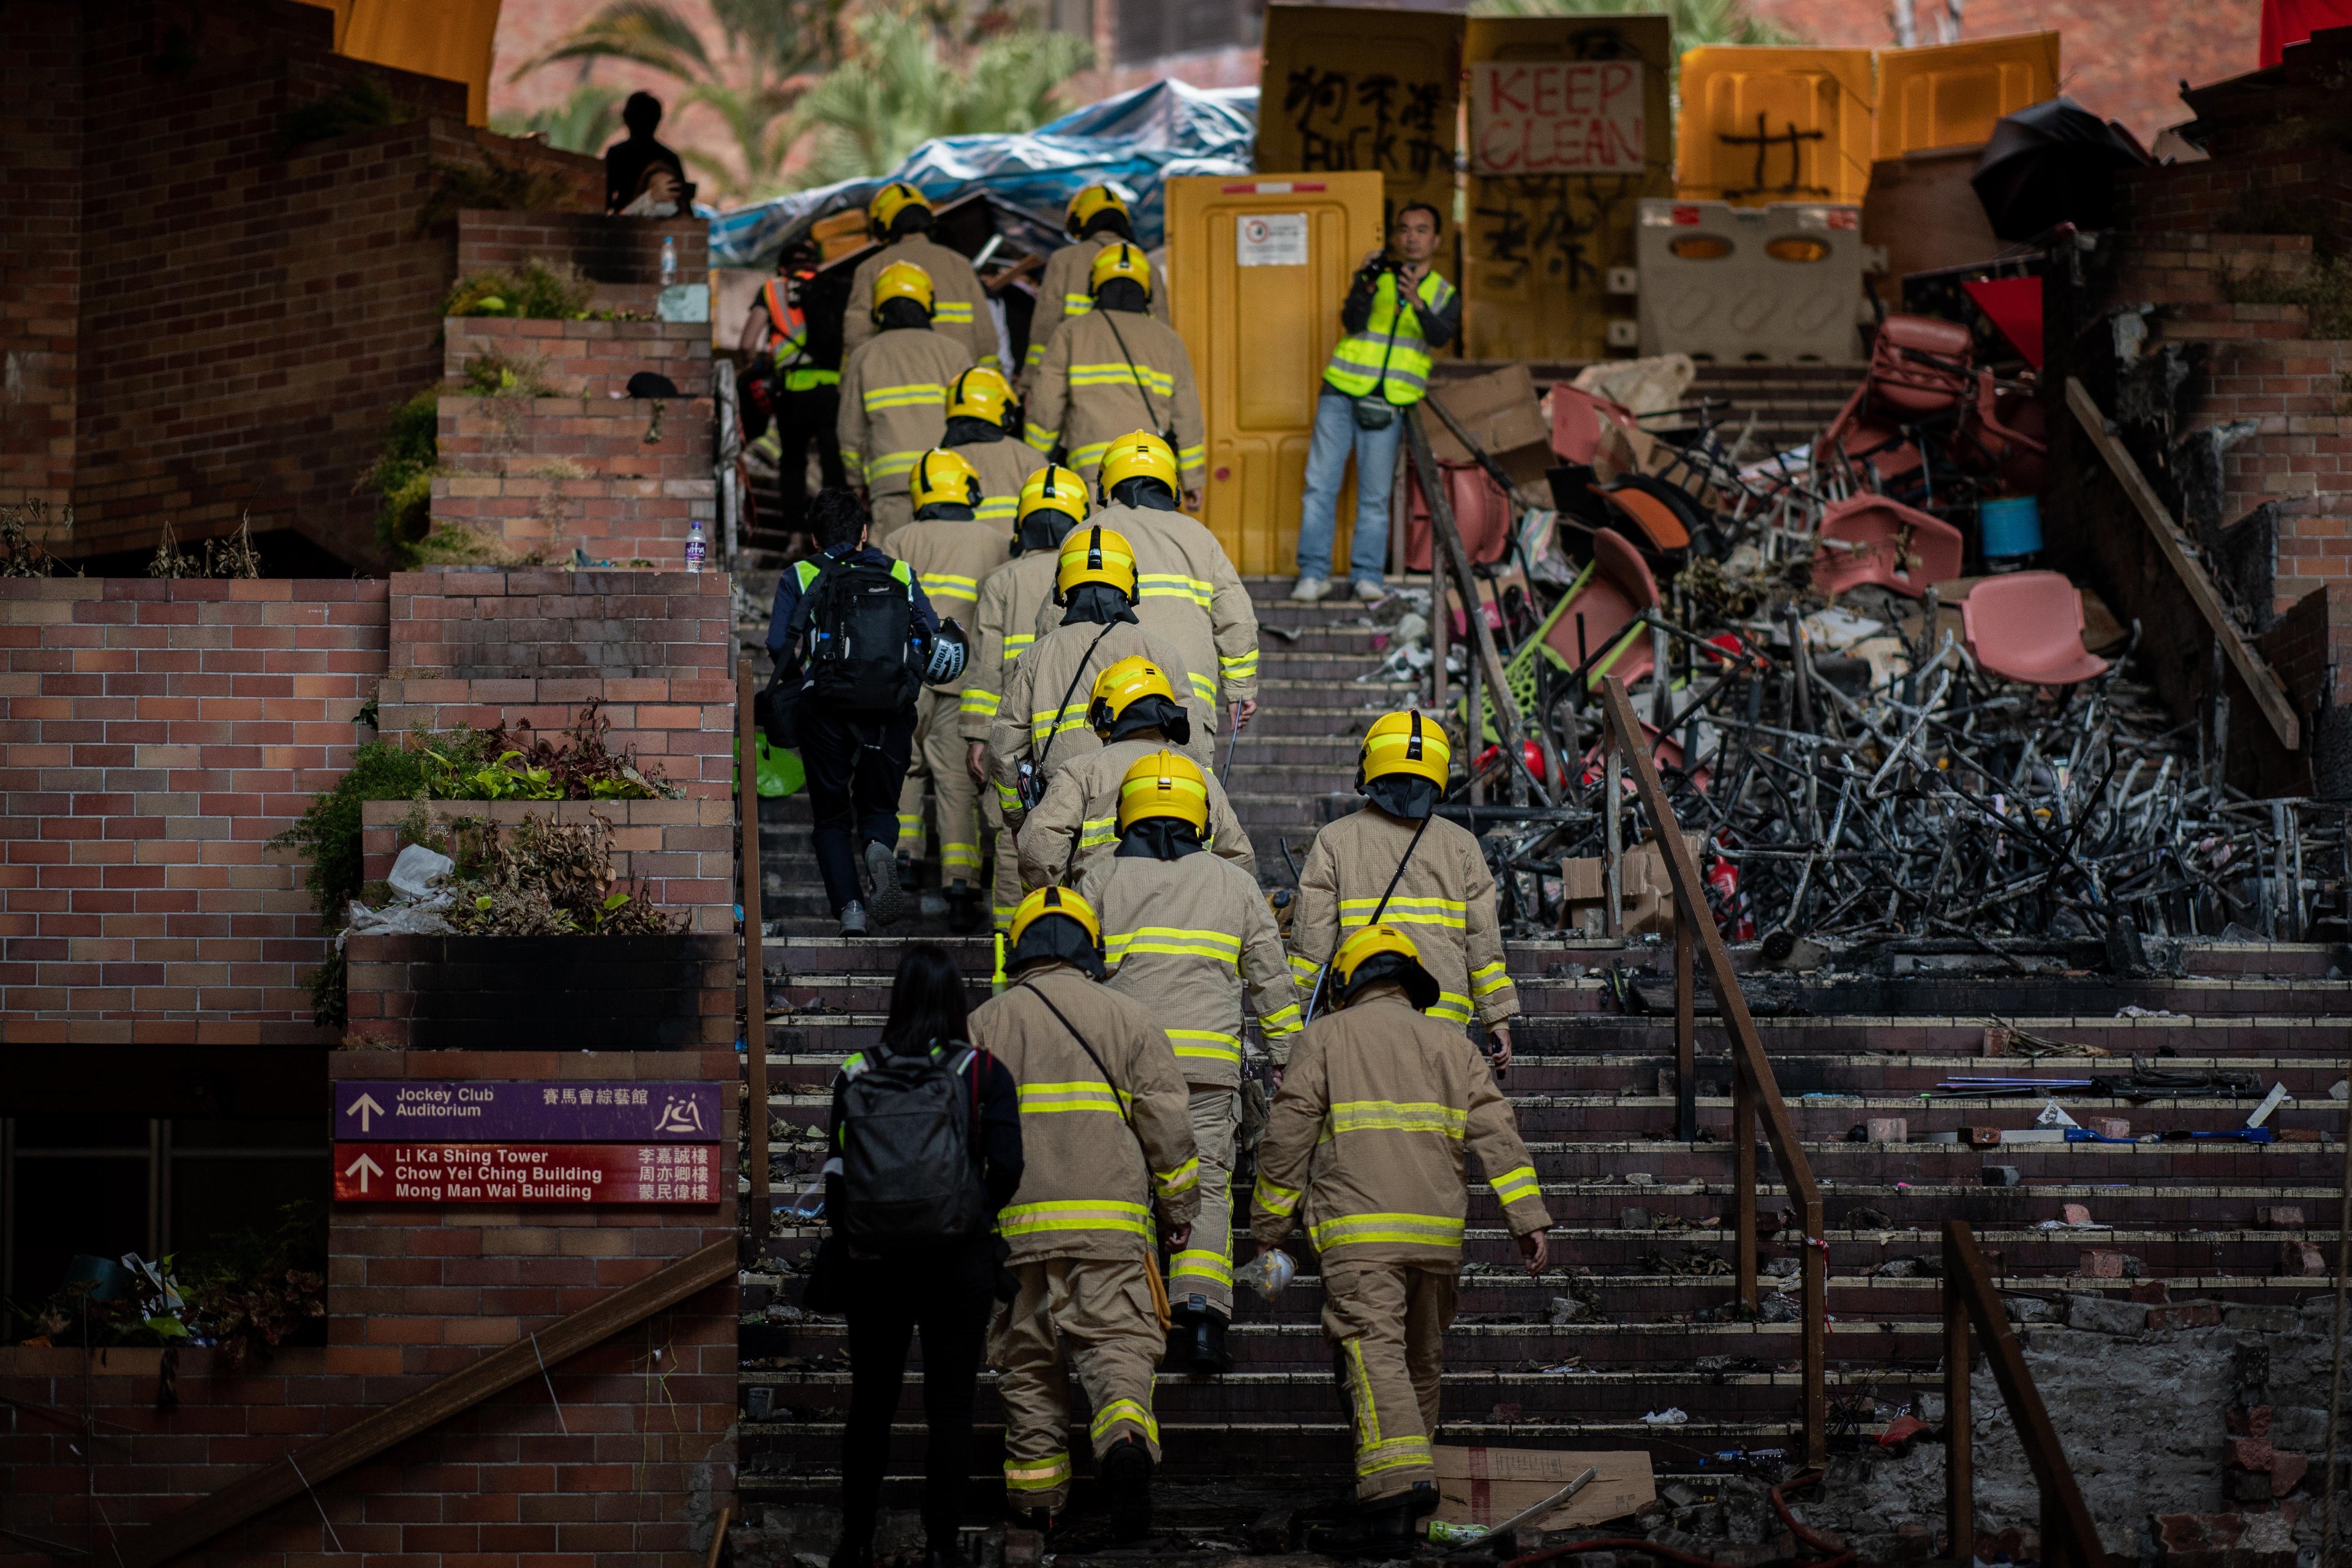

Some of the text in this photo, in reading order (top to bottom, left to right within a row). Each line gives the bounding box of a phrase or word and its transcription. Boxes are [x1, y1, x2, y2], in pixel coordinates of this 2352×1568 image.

[1490, 62, 1634, 116] KEEP
[1478, 117, 1643, 171] CLEAN
[687, 542, 704, 554] vita
[952, 646, 961, 673] KYODO
[396, 1088, 494, 1103] Jockey Club
[543, 1088, 648, 1105] 賽馬會綜藝館
[396, 1104, 481, 1116] Auditorium
[396, 1149, 548, 1166] Li Ka Shing Tower
[638, 1147, 708, 1164] 李嘉誠樓
[396, 1167, 602, 1184] Chow Yei Ching Building
[639, 1166, 709, 1182] 周亦卿樓
[396, 1184, 591, 1200] Mong Man Wai Building
[638, 1184, 708, 1200] 蒙民偉樓
